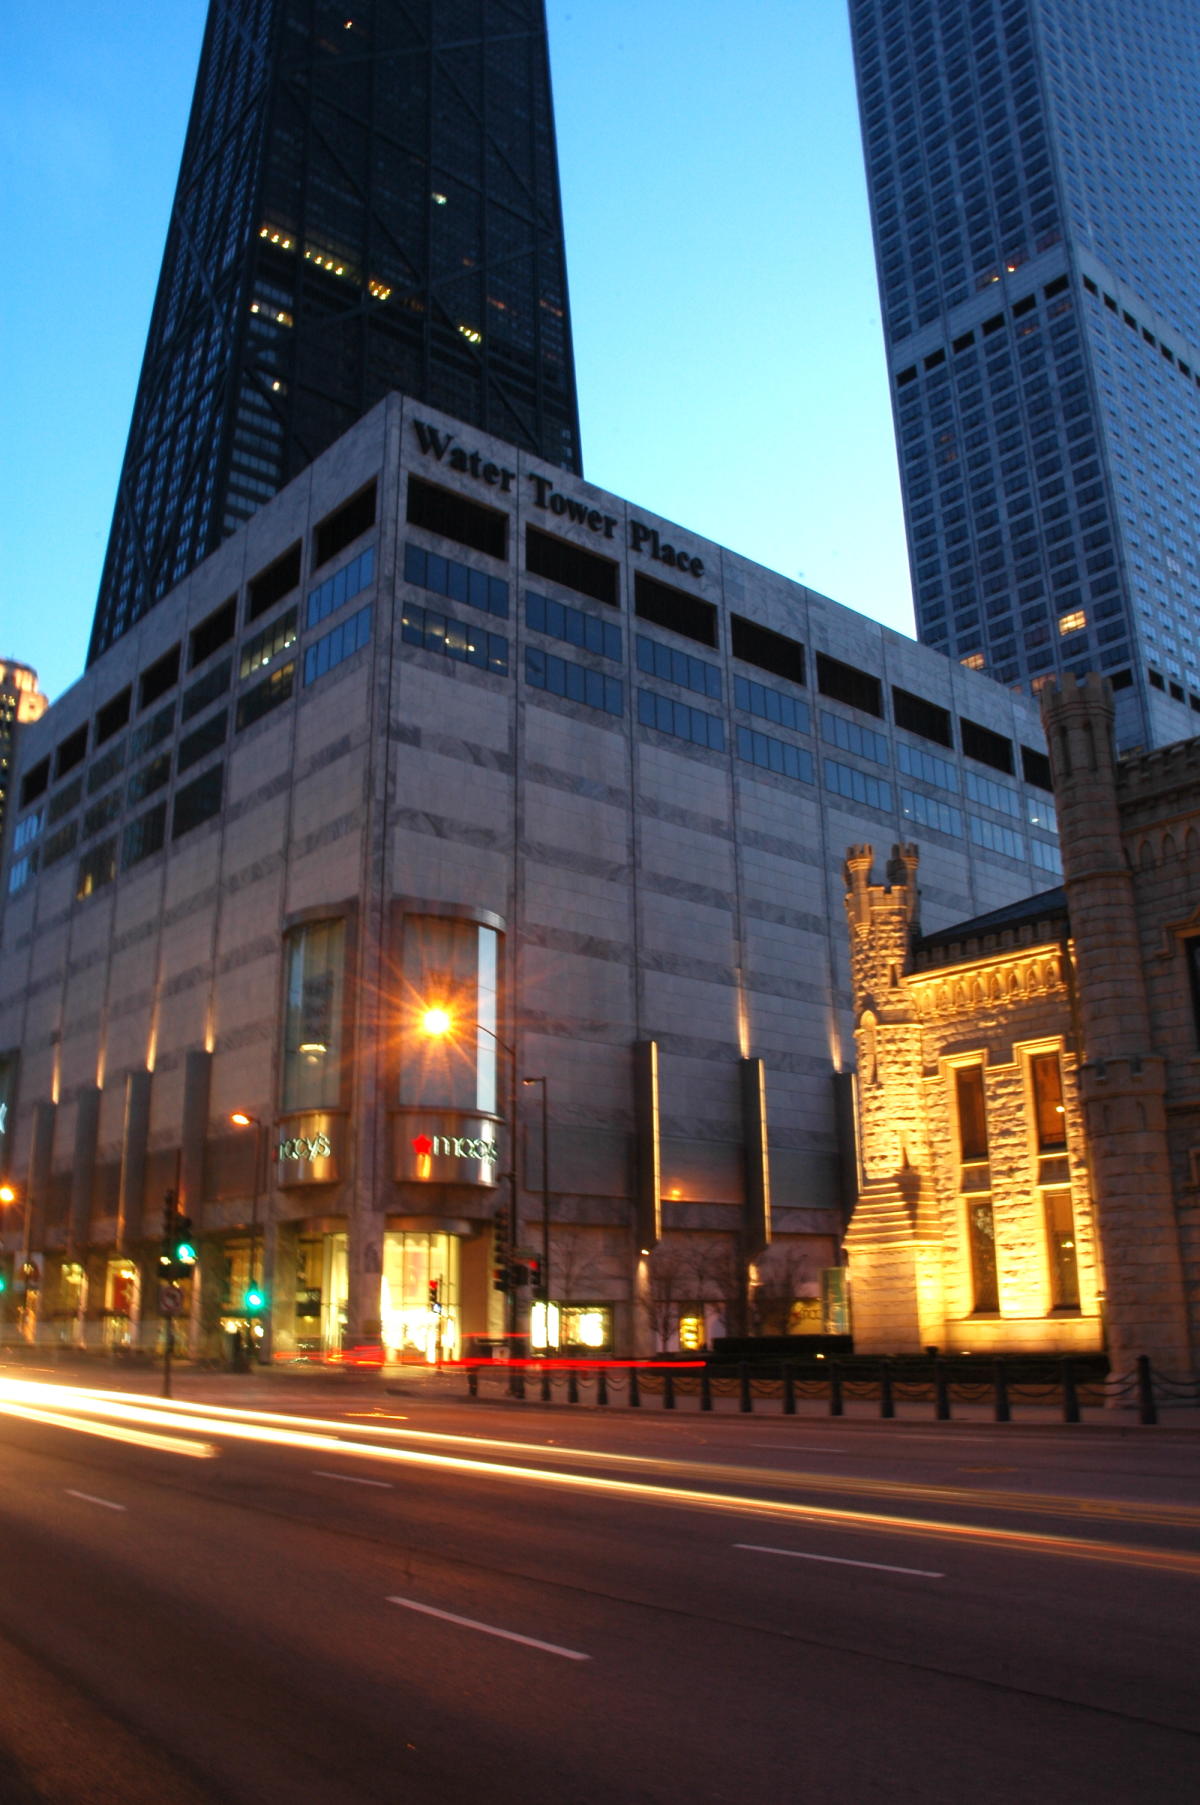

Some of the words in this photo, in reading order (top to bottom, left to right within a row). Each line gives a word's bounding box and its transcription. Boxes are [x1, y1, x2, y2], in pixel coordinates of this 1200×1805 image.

[414, 420, 514, 491] Water
[528, 473, 617, 539] Tower
[631, 520, 704, 578] Place
